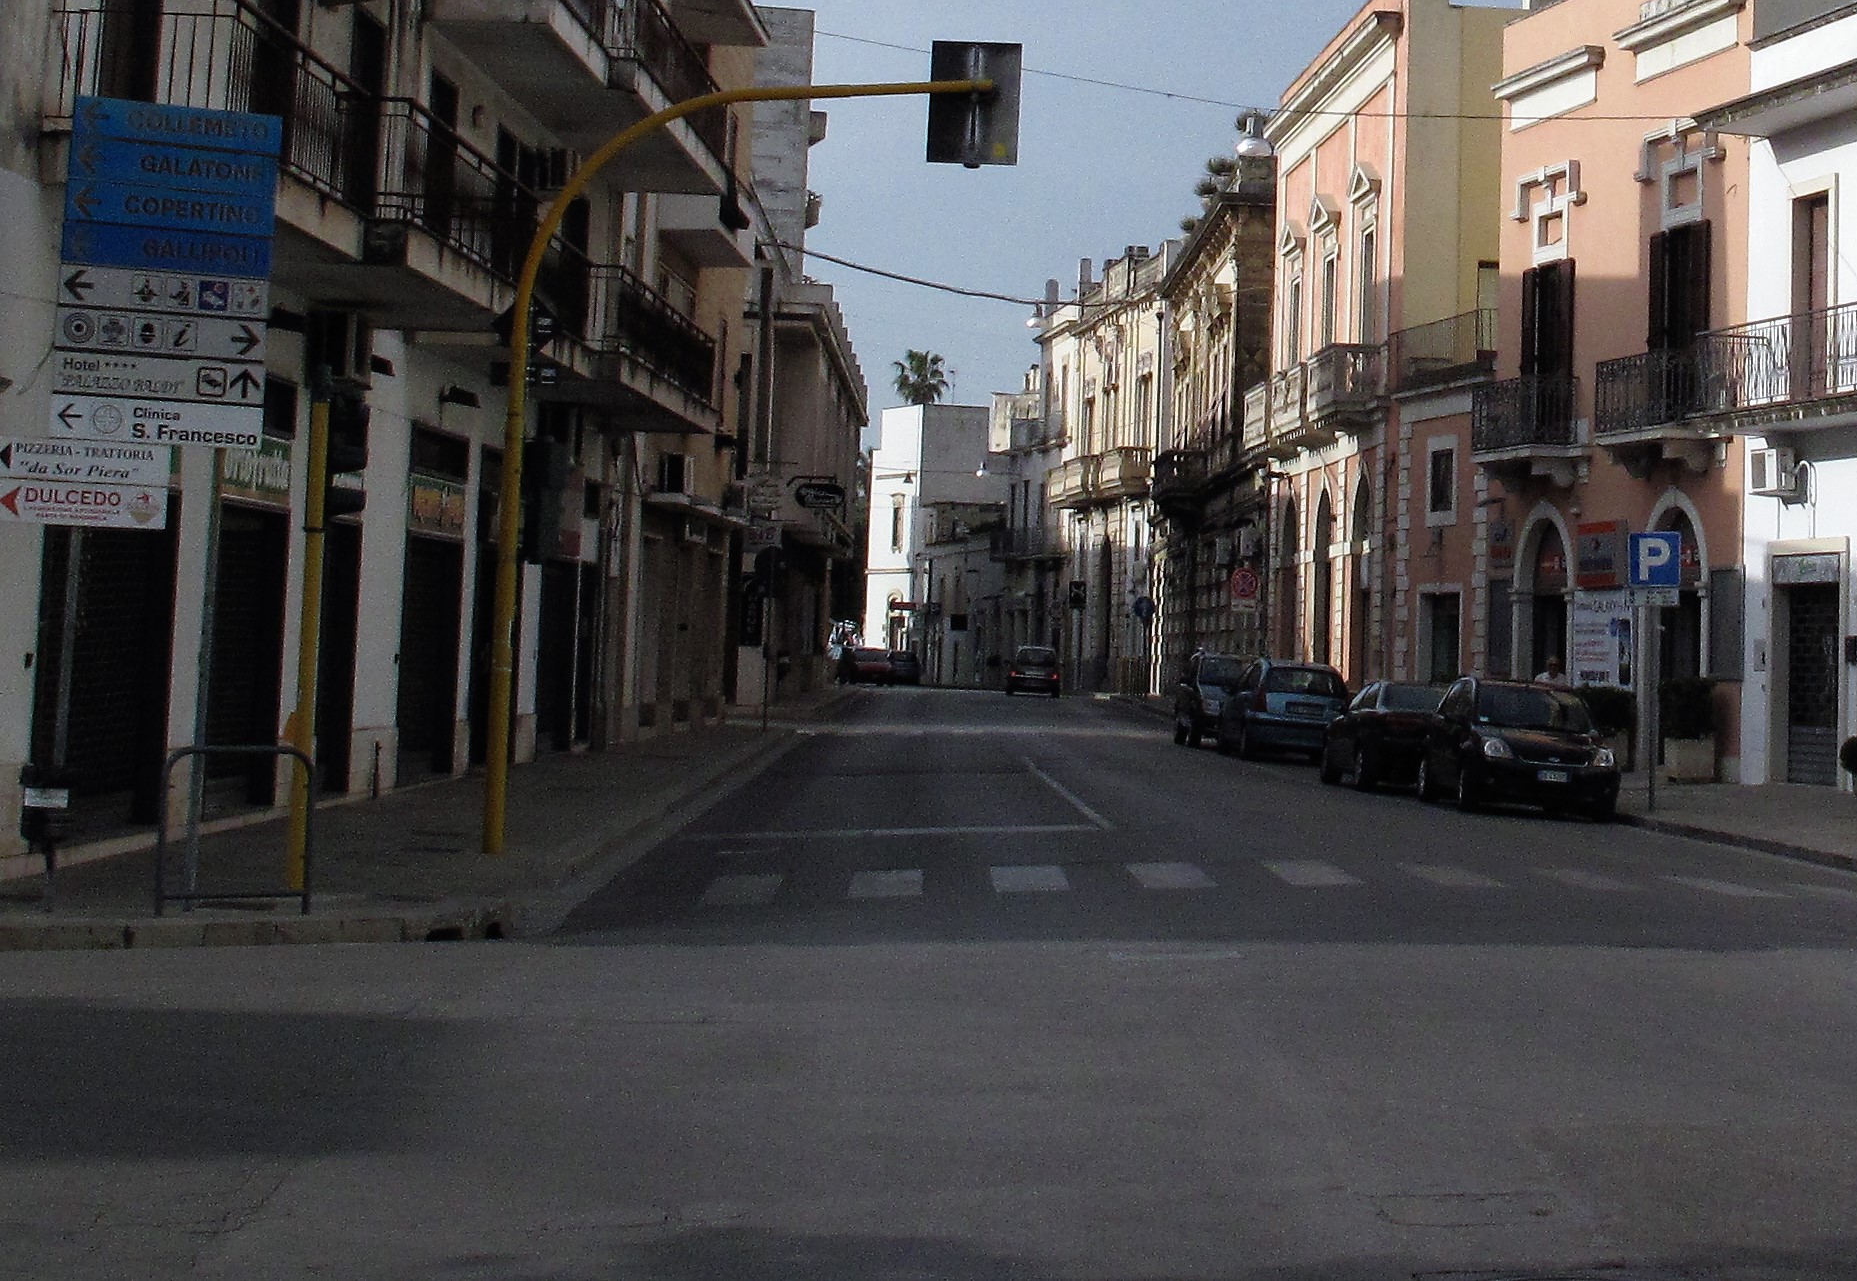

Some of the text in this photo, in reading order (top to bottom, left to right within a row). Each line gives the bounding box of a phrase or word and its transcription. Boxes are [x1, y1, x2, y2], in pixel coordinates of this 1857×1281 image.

[141, 155, 262, 180] GALATONE
[125, 195, 259, 224] COPERTINO
[63, 357, 100, 371] Hotel
[133, 407, 181, 421] Clinica
[132, 423, 258, 446] S. Francesco
[16, 443, 75, 457] PIZZERIA
[85, 447, 155, 461] TRATTORIA
[25, 487, 122, 506] DULCEDO
[1638, 537, 1671, 581] P
